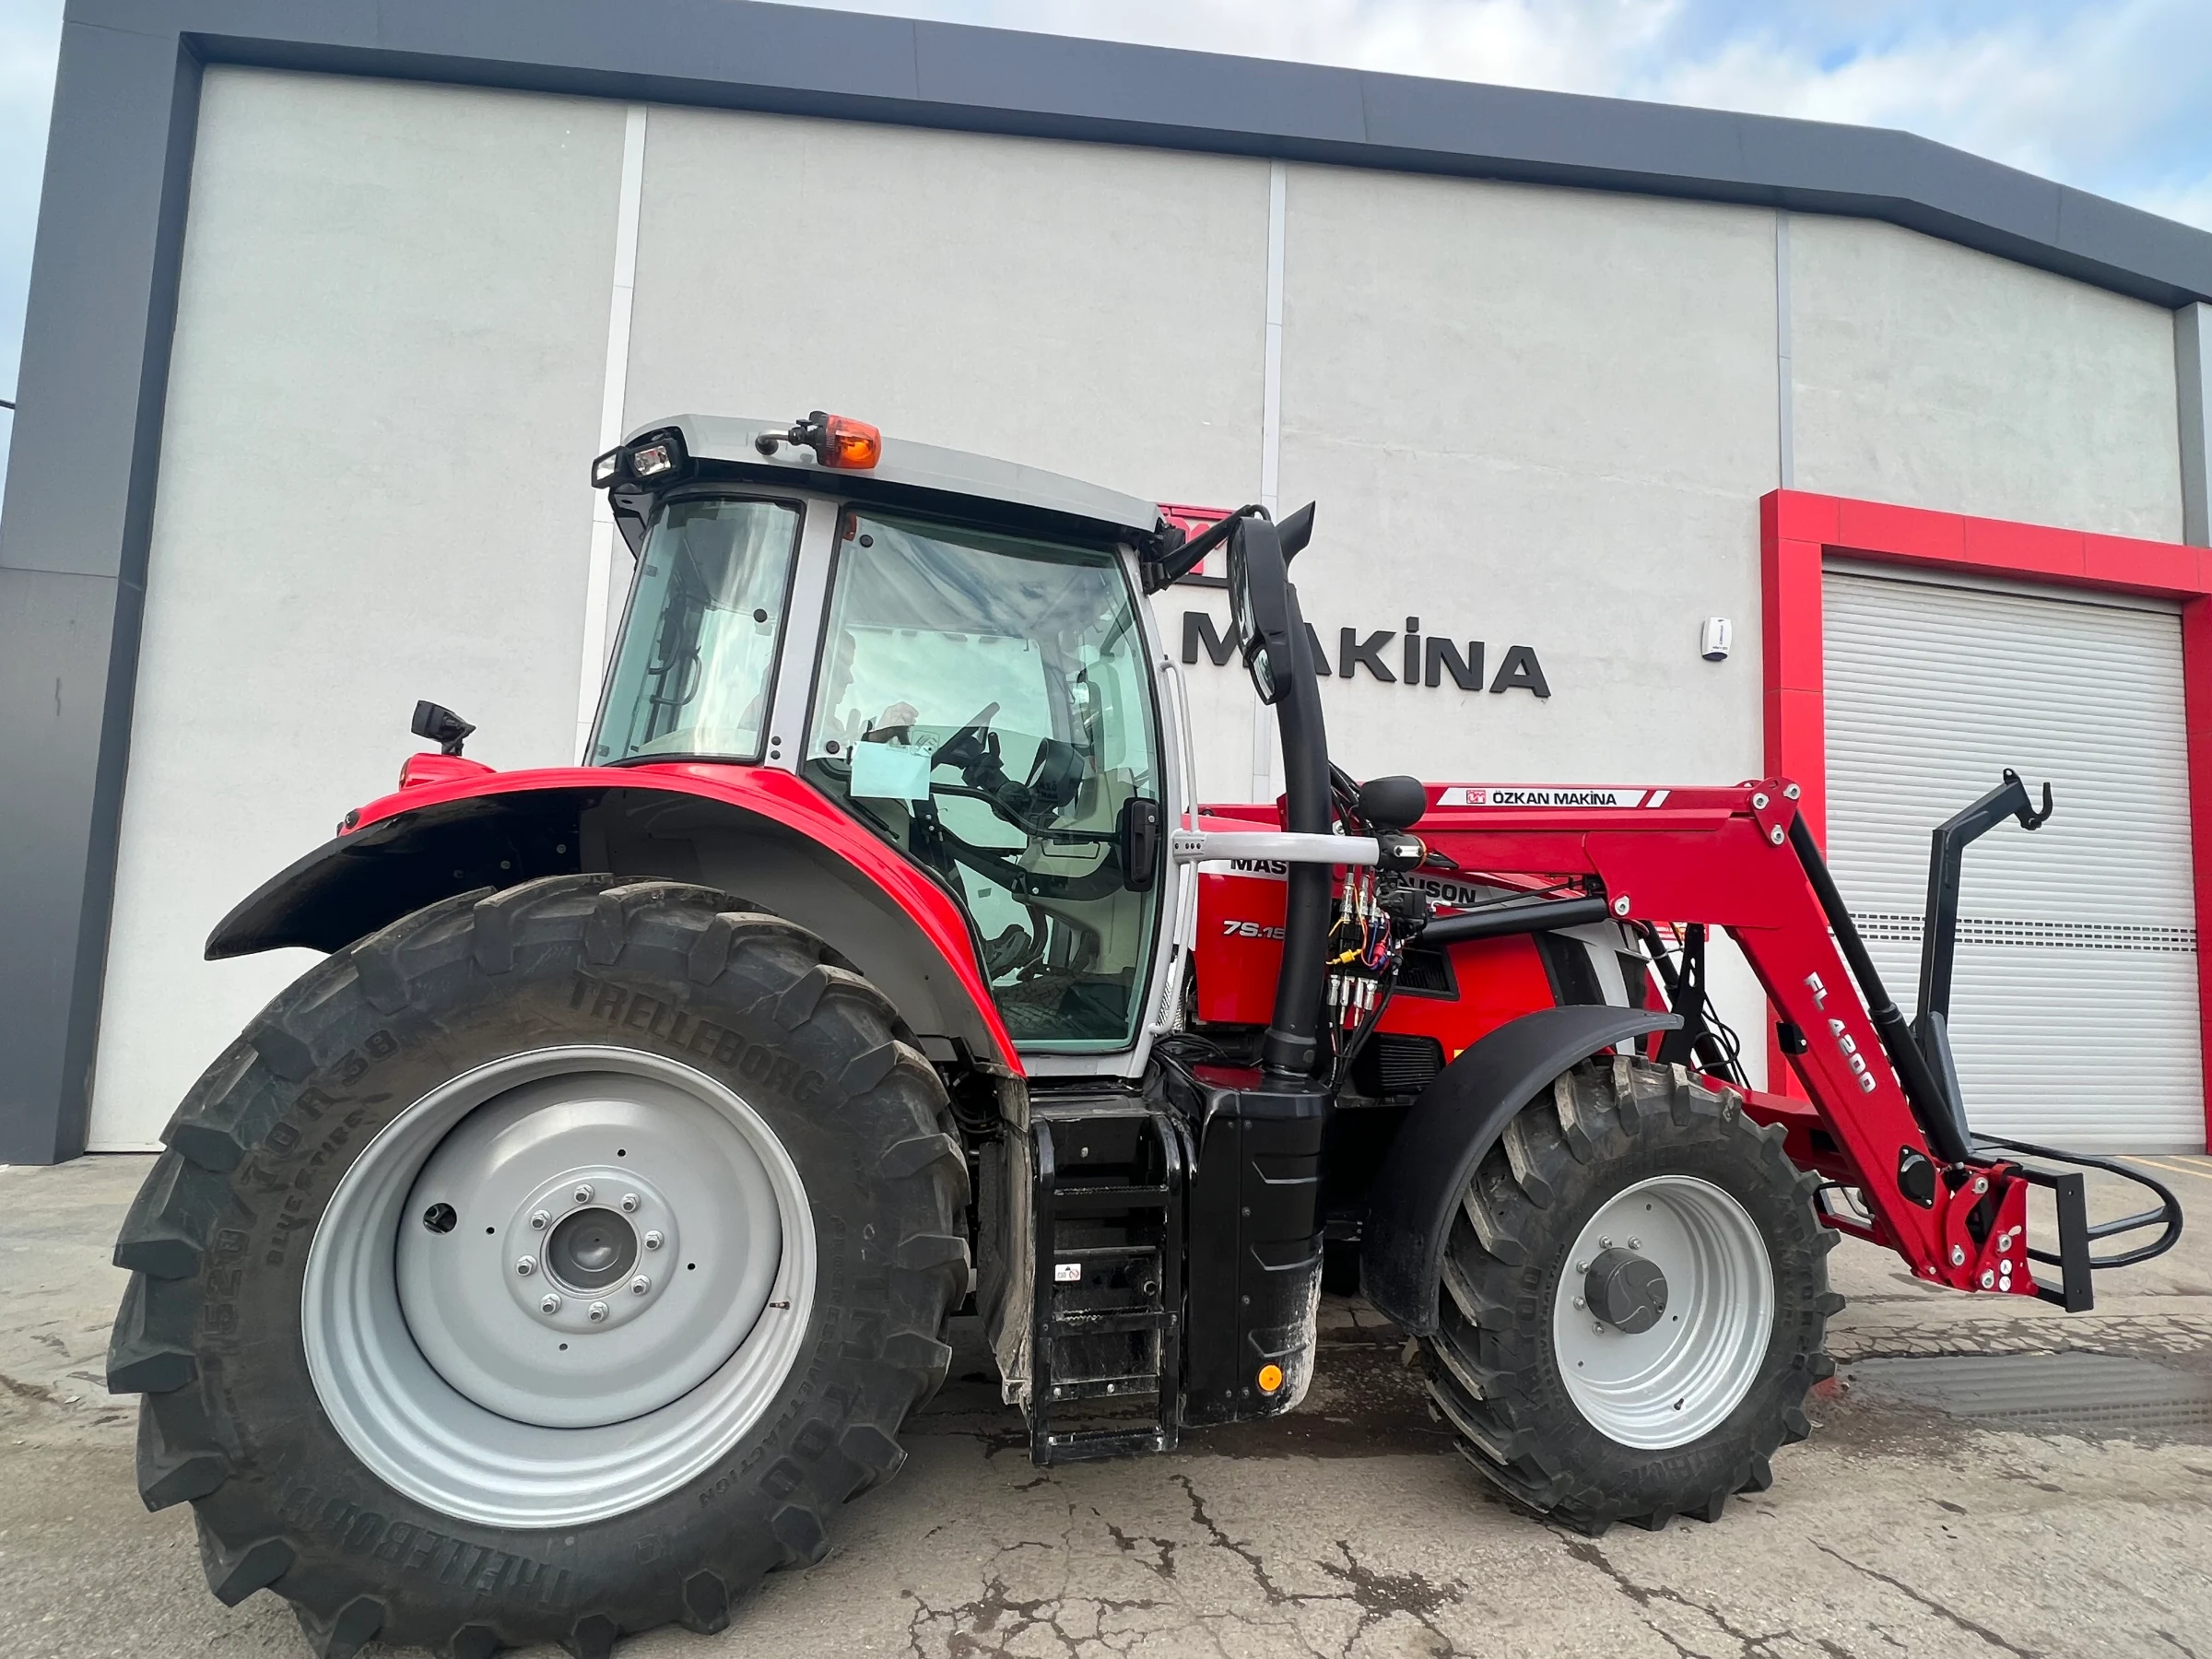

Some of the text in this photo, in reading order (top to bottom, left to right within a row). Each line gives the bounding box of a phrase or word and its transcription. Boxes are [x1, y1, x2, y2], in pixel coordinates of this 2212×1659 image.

[1493, 790, 1549, 805] ÖZKAN
[1555, 791, 1617, 806] MAKİNA
[1230, 859, 1287, 875] MAS
[1223, 920, 1286, 939] 7S.15
[570, 973, 827, 1107] TRELLEBORG
[1805, 971, 1877, 1093] FL 4200
